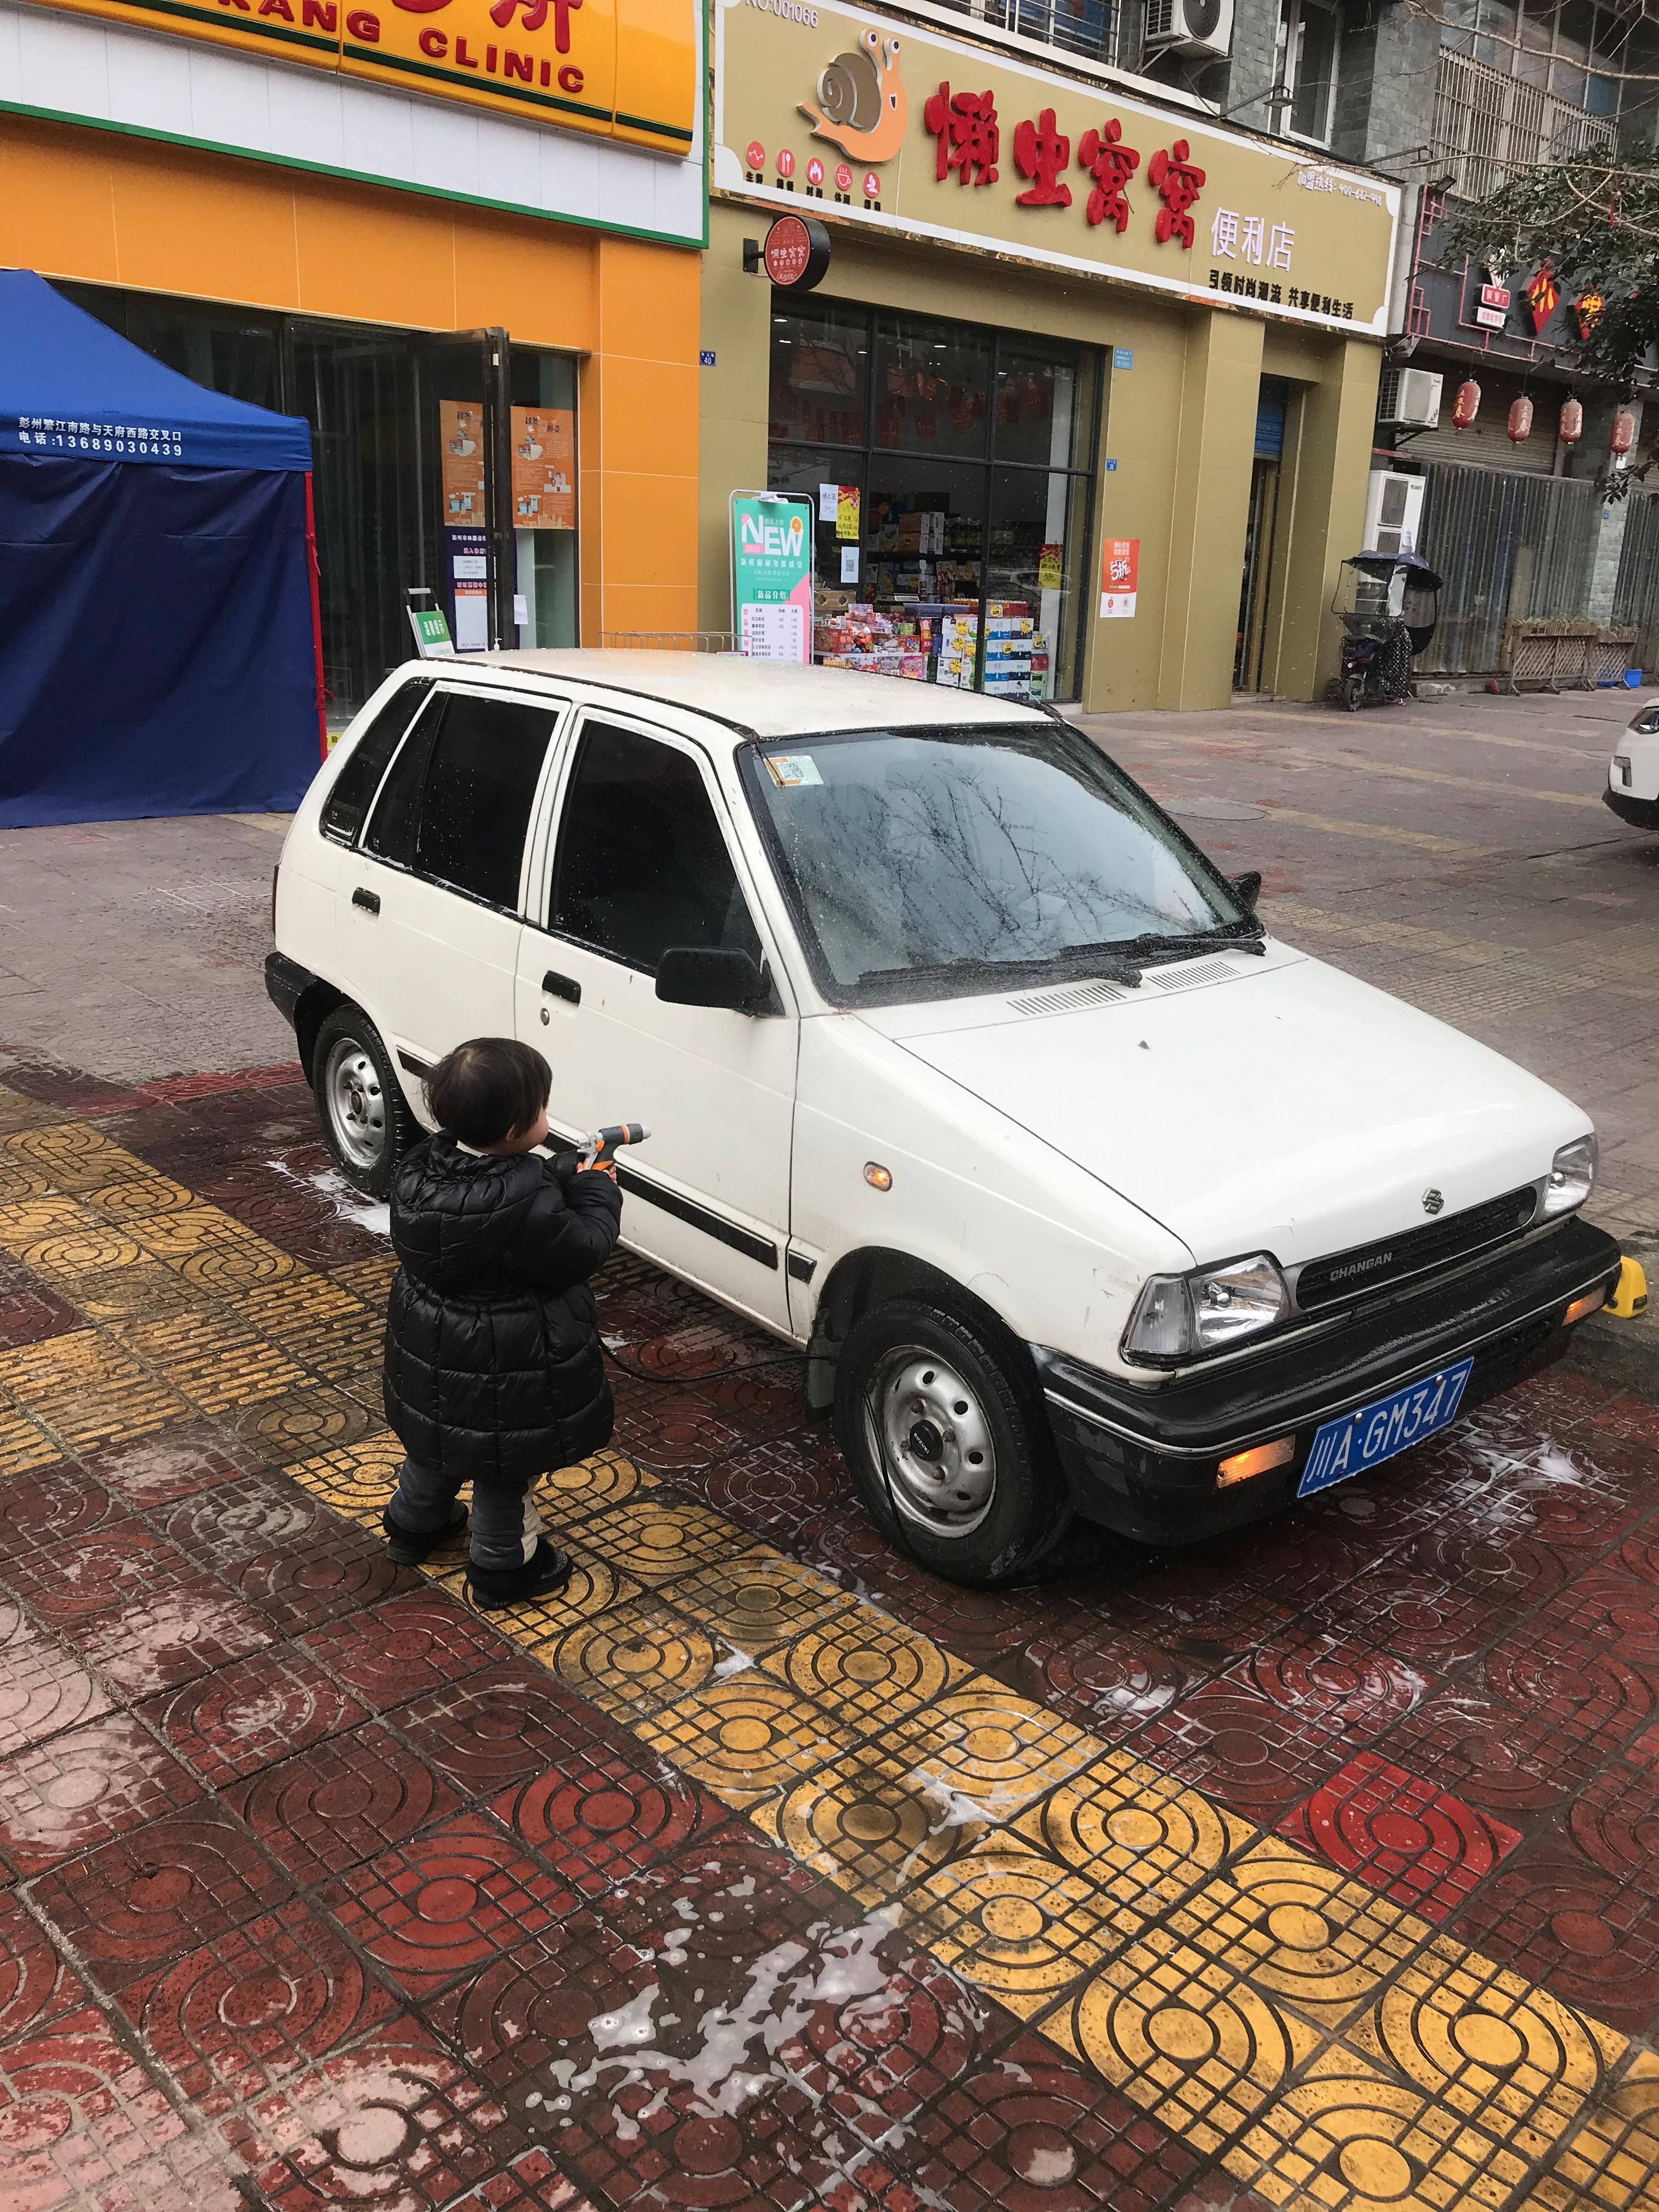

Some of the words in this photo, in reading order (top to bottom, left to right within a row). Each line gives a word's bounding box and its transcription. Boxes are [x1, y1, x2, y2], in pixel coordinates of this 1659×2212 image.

[419, 27, 584, 93] CLINIC
[924, 81, 1206, 250] 懒虫窝窝
[1211, 206, 1295, 272] 便利店
[1209, 269, 1282, 304] 引领时尚潮流
[1289, 286, 1354, 320] 共享便利生活
[19, 416, 182, 442] 彭州繁江南路与天府西路交叉口
[742, 514, 804, 556] NEW
[757, 589, 786, 600] 新品介绍
[1330, 1252, 1392, 1282] CHANGAN
[913, 1432, 930, 1454] SUZUKI
